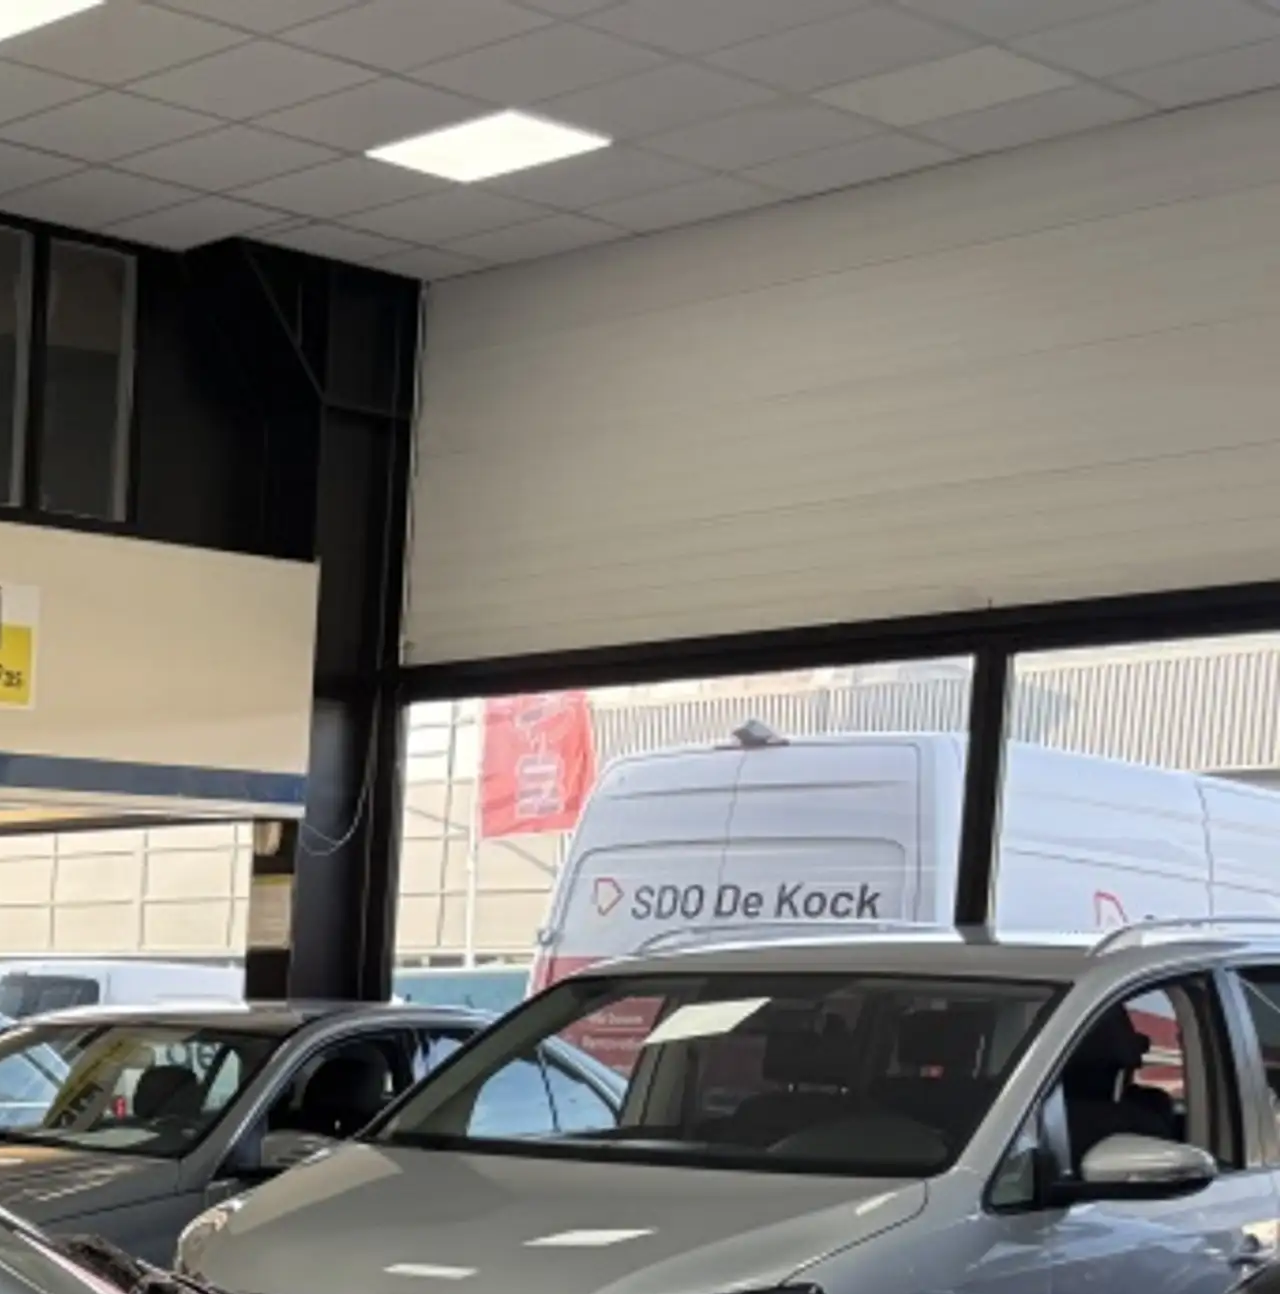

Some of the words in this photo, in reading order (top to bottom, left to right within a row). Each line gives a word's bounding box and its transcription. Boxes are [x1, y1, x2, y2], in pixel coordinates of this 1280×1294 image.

[631, 884, 705, 920] SDO
[713, 884, 764, 919] De
[774, 882, 881, 920] Kock
